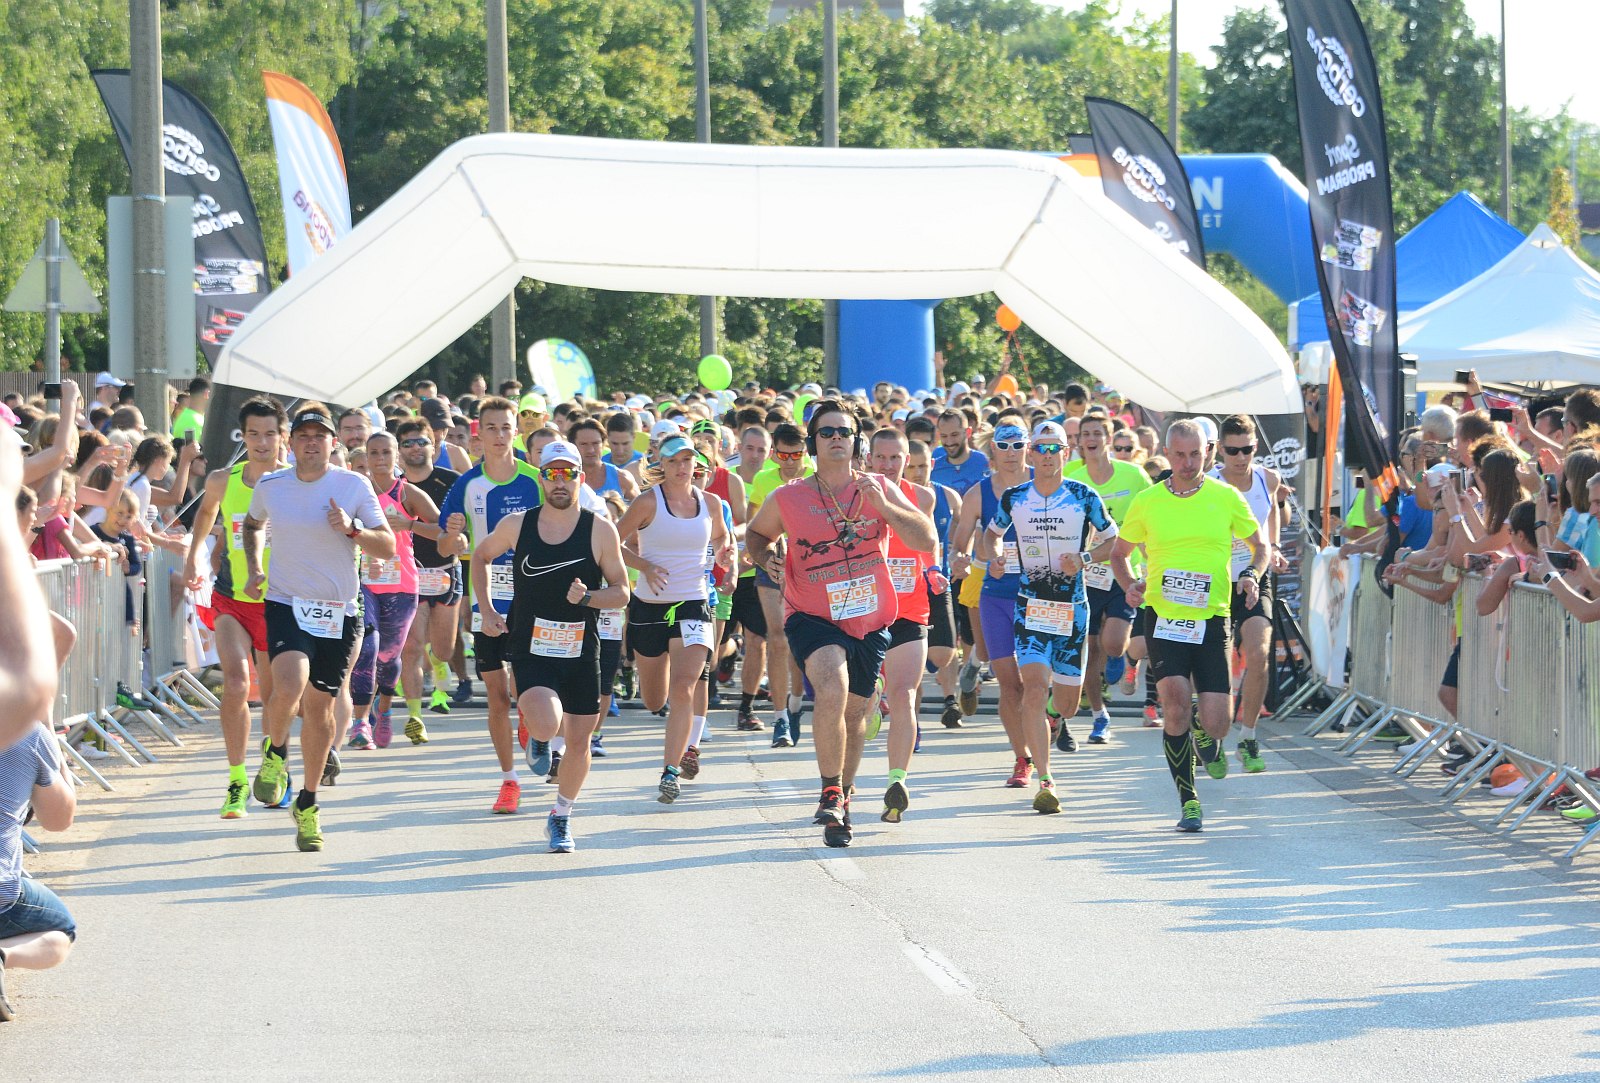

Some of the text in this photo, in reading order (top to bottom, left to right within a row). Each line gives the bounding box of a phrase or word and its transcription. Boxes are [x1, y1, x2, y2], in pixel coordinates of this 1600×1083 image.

[1191, 176, 1224, 211] N
[1202, 213, 1223, 229] ET
[506, 506, 527, 515] KAYS
[892, 566, 912, 577] 34
[1163, 576, 1207, 592] 3082
[831, 585, 873, 604] 0303
[301, 606, 333, 620] V34
[1029, 607, 1069, 620] 0088
[1166, 618, 1196, 629] V28
[539, 629, 577, 642] 0186
